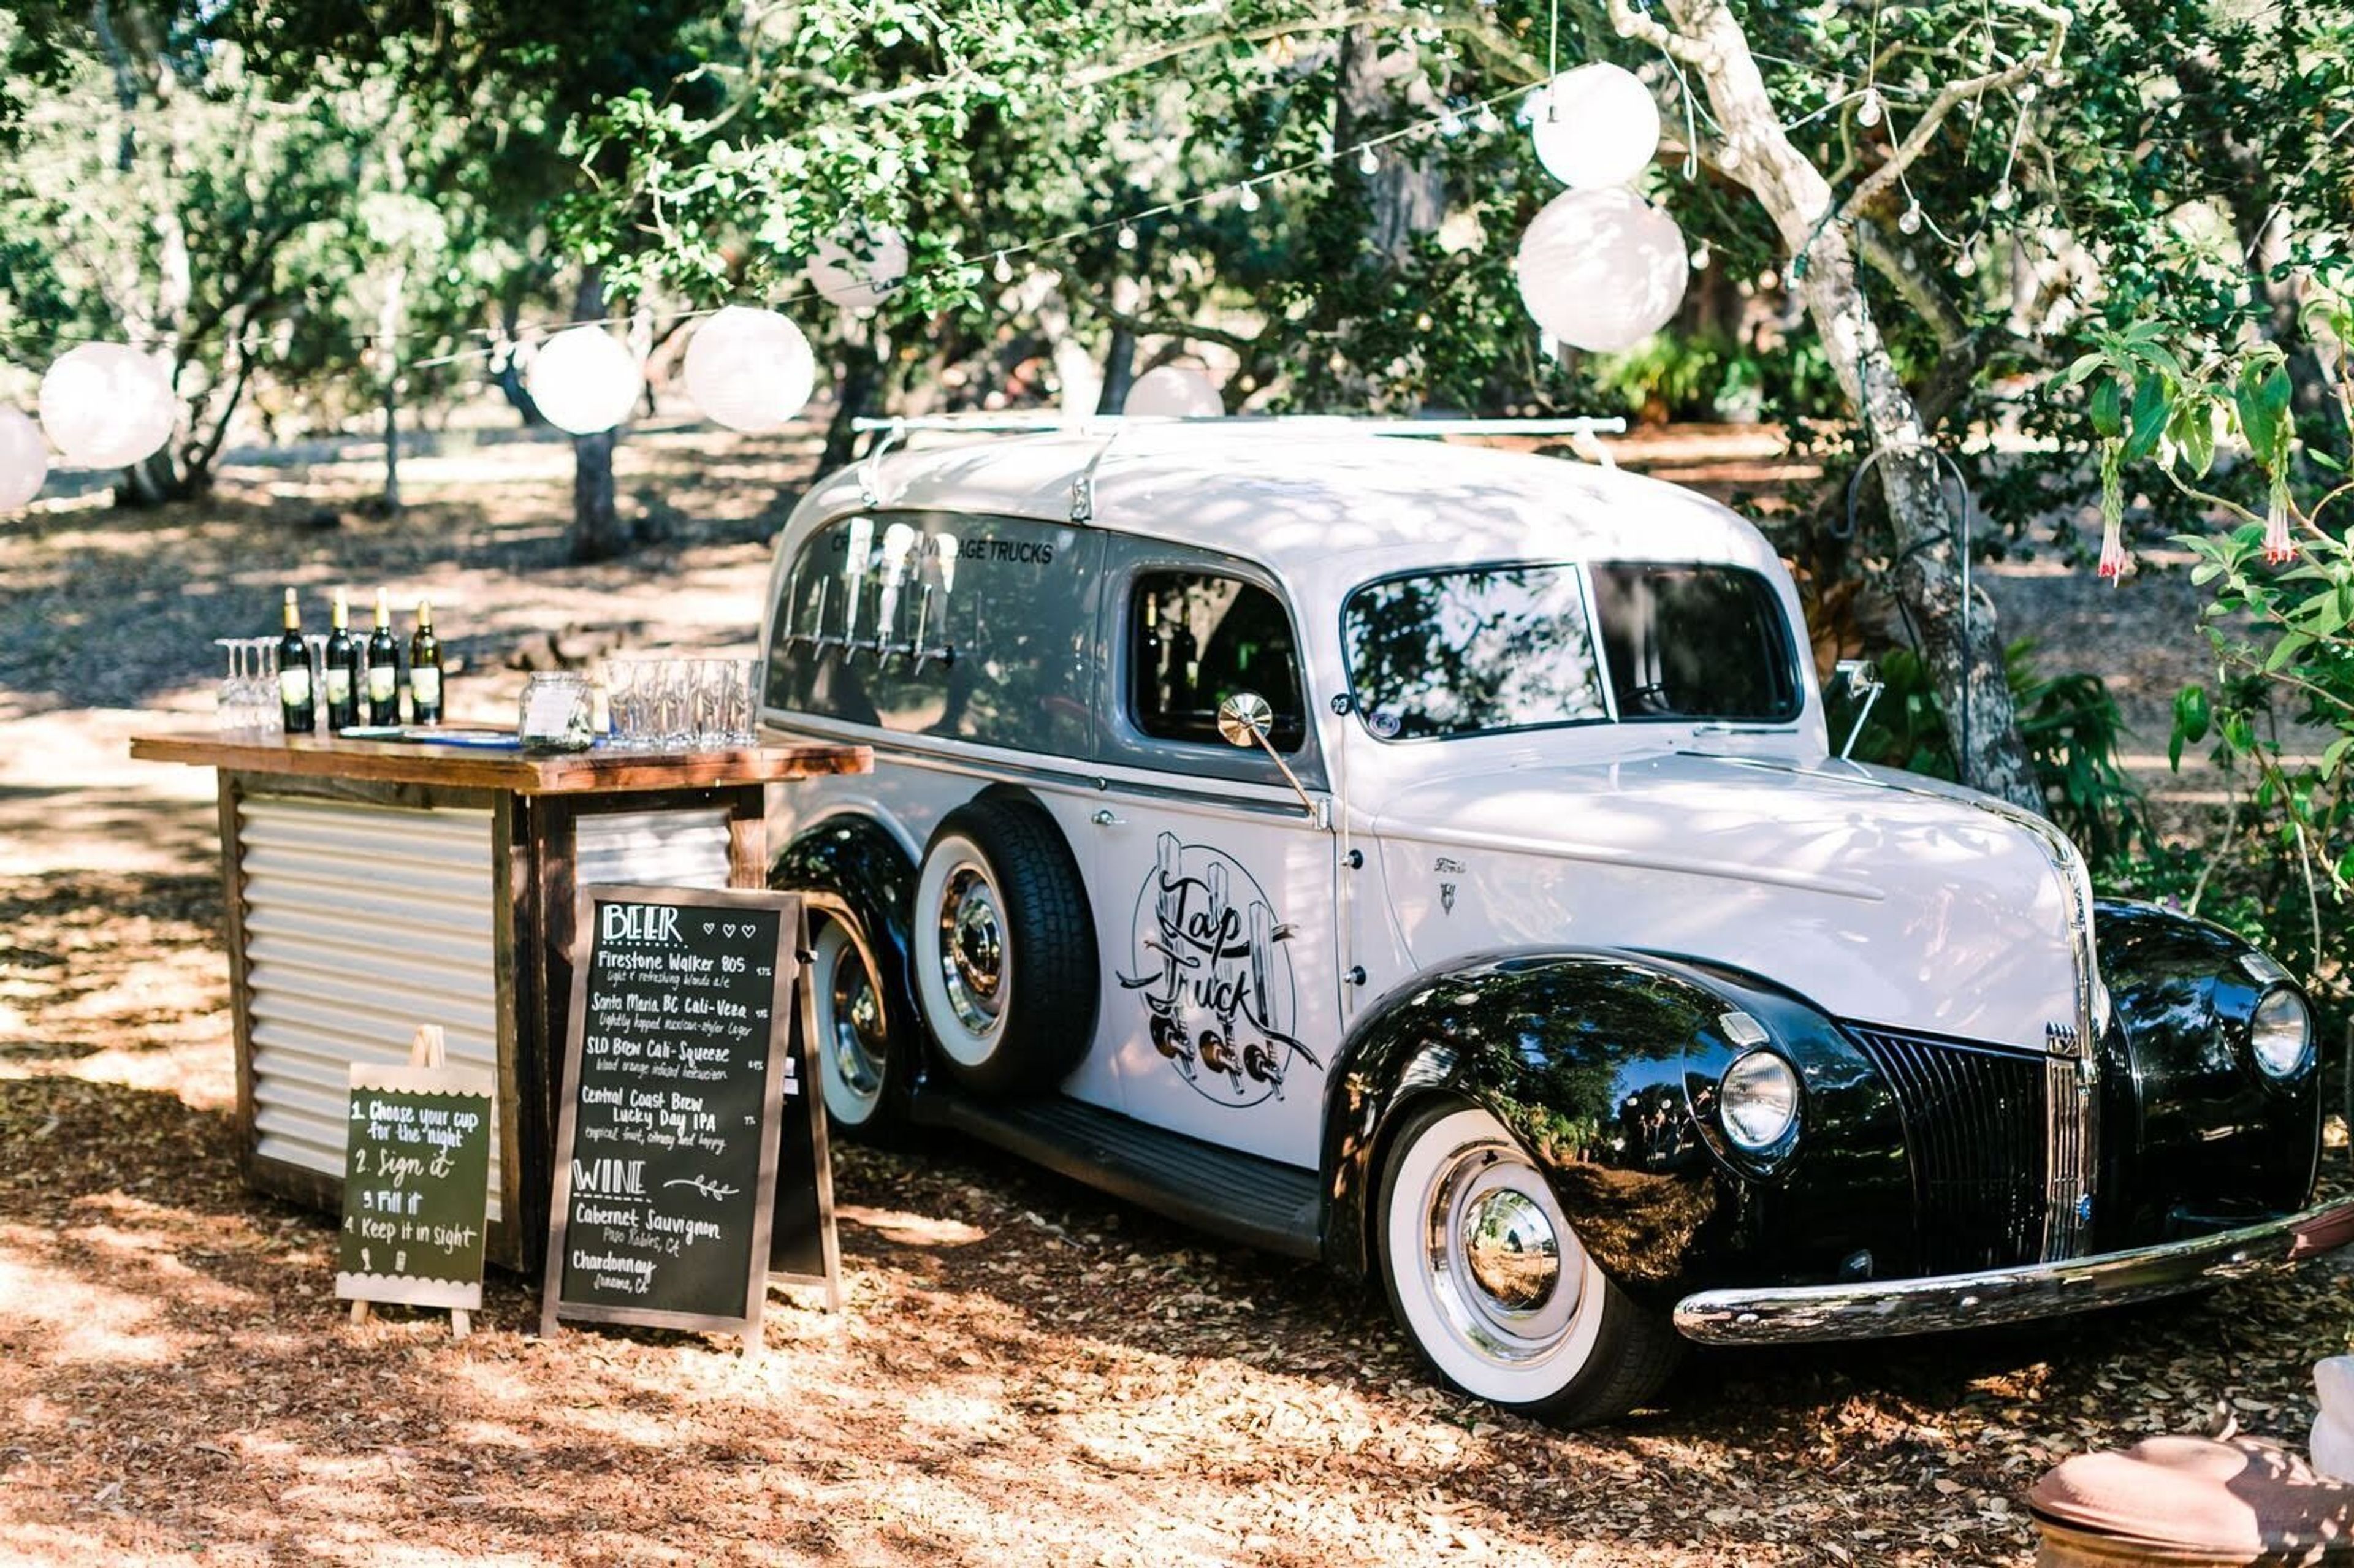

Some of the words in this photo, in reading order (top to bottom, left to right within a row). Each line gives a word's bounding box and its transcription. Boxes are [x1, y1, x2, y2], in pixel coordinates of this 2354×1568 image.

[990, 541, 1053, 564] TRUCKS
[603, 905, 684, 941] BEER
[1156, 871, 1241, 970] Tap
[598, 950, 663, 970] Firestone
[669, 953, 715, 972] Walker
[721, 955, 745, 972] 805
[592, 992, 622, 1011] Santa
[627, 994, 659, 1012] Maria
[663, 994, 679, 1013] BC
[587, 1036, 609, 1055] SLO
[613, 1037, 641, 1056] Brew
[622, 1061, 649, 1079] orange
[582, 1086, 623, 1106] Central
[630, 1089, 665, 1109] Coast
[671, 1092, 703, 1112] Brew
[369, 1100, 415, 1124] Choose
[419, 1108, 449, 1133] your
[453, 1111, 479, 1133] cup
[613, 1106, 653, 1130] Lucky
[660, 1109, 686, 1138] Day
[693, 1113, 716, 1132] IPA
[367, 1121, 392, 1140] for
[395, 1123, 421, 1143] the
[427, 1126, 463, 1154] night
[377, 1147, 424, 1188] Sign
[430, 1152, 455, 1178] it
[573, 1159, 647, 1194] WINE
[377, 1190, 402, 1214] Fill
[408, 1190, 424, 1216] it
[361, 1217, 397, 1245] Keep
[402, 1220, 413, 1240] it
[416, 1223, 430, 1243] in
[434, 1224, 478, 1255] sight
[576, 1202, 639, 1228] Cabernet
[645, 1209, 722, 1246] Sauvignon
[573, 1250, 658, 1284] Chardonnay
